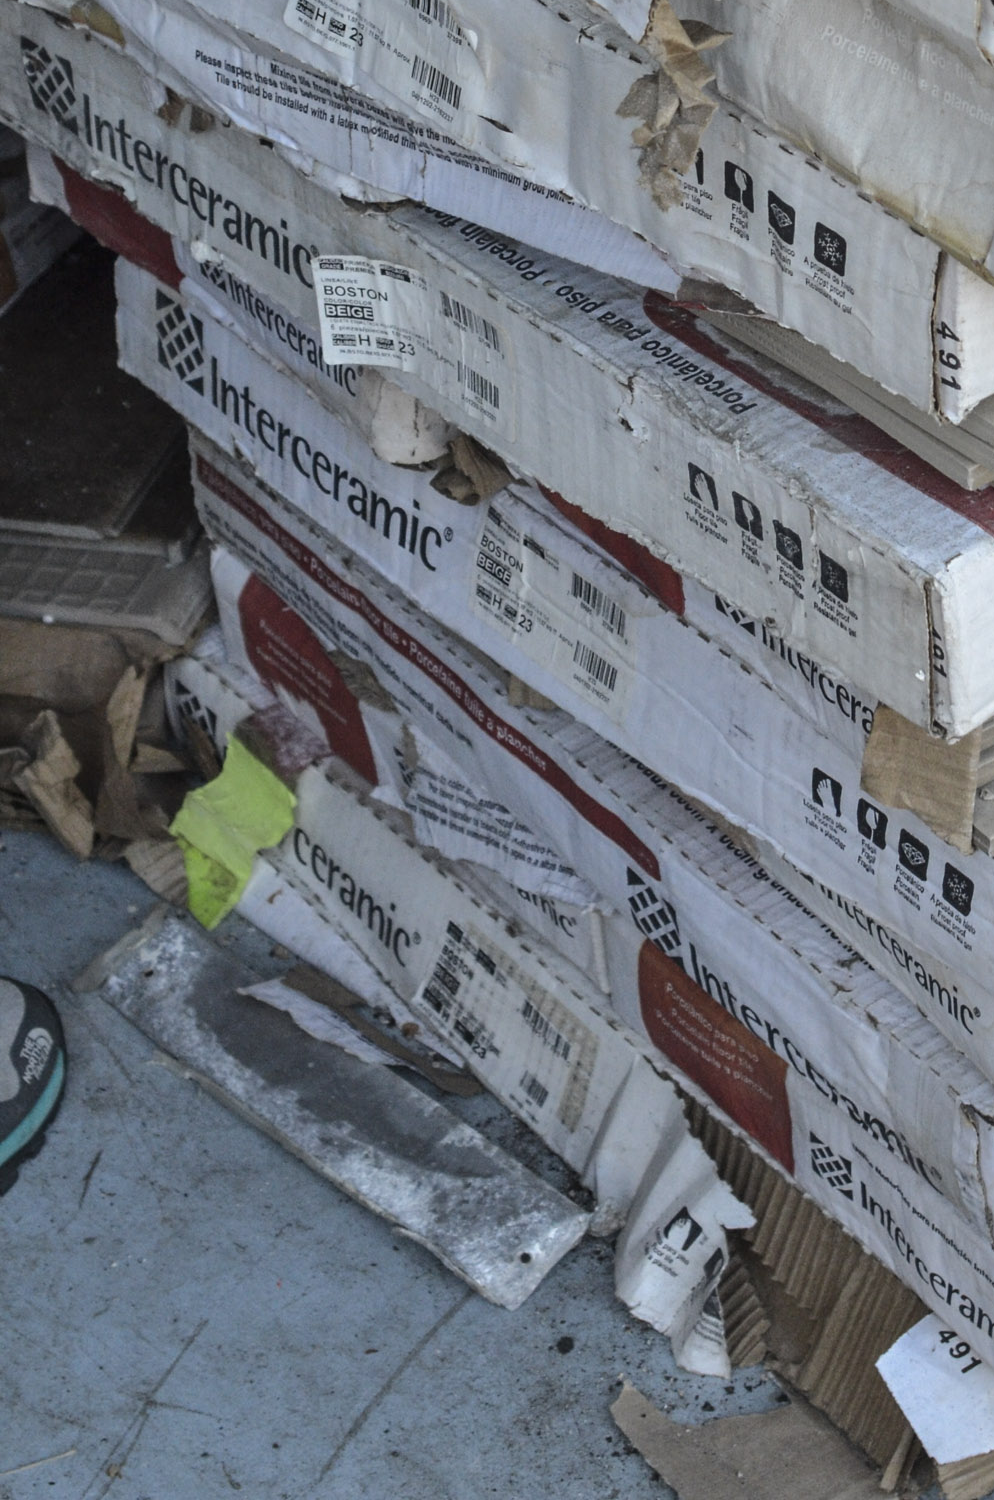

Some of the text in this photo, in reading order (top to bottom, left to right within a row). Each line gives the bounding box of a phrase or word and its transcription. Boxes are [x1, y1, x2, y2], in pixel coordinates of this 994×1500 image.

[349, 25, 365, 48] 23
[819, 23, 900, 76] Porcelaine
[195, 49, 299, 98] Please inspect these tiles
[231, 76, 522, 187] should installed minimum
[323, 284, 389, 302] BOSTON
[324, 304, 374, 320] BEIGE
[459, 219, 758, 416] Porcelain piso para Porcelánico
[397, 340, 416, 357] 23
[936, 320, 962, 391] 491
[476, 552, 512, 586] BEIGE
[479, 533, 525, 574] BOSTON
[518, 613, 534, 634] 23
[470, 1041, 488, 1060] 23
[937, 1329, 983, 1375] 491
